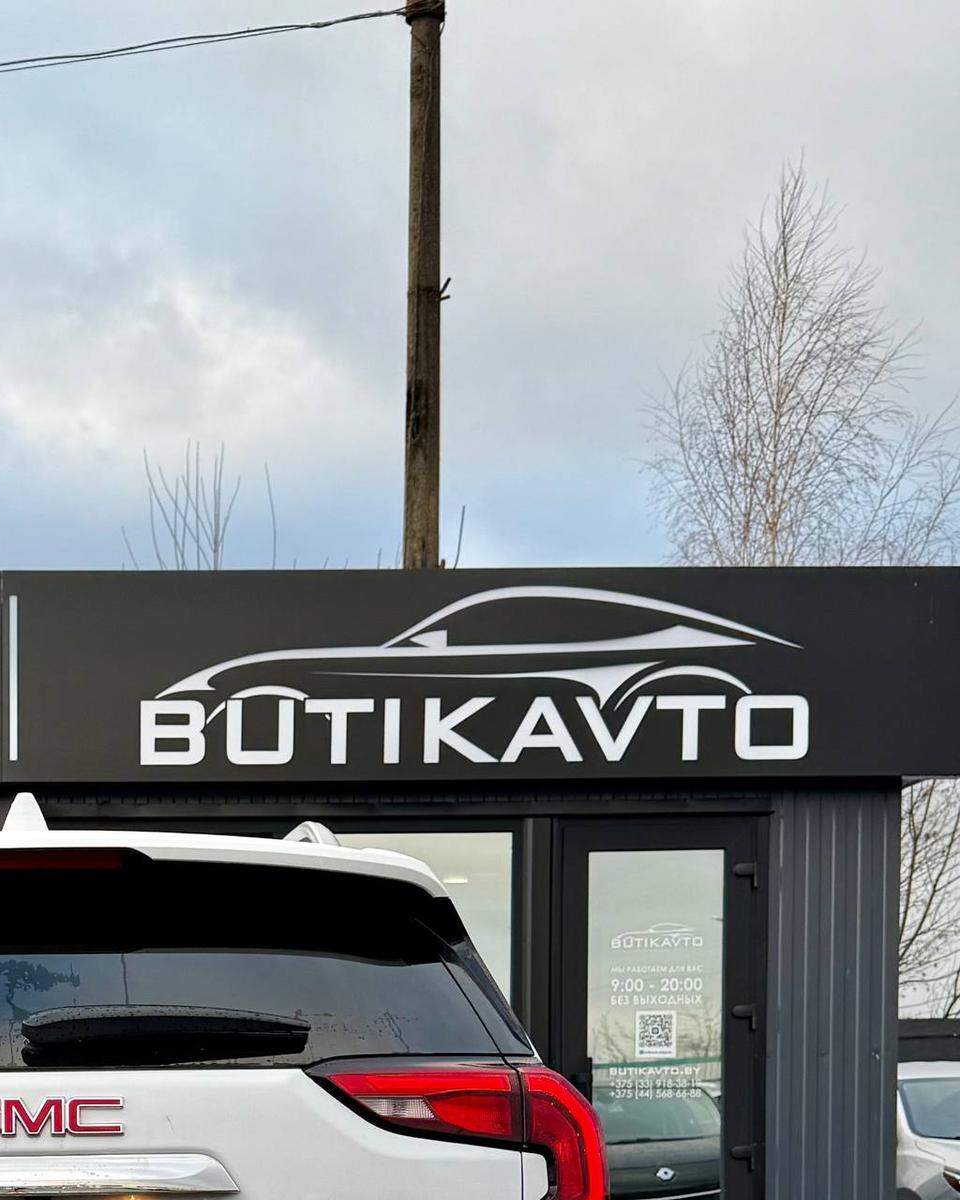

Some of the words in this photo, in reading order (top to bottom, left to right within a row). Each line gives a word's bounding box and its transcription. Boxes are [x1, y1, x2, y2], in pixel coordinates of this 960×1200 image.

[140, 694, 809, 765] BUTIKAVTO
[611, 936, 703, 949] BUTIKAVTO
[611, 978, 643, 992] 9:00
[660, 977, 703, 991] 20:00
[611, 995, 630, 1005] БЕЗ
[633, 994, 702, 1005] ВЫХОДНЫХ
[609, 1067, 701, 1075] BUTIKAVTO.BY
